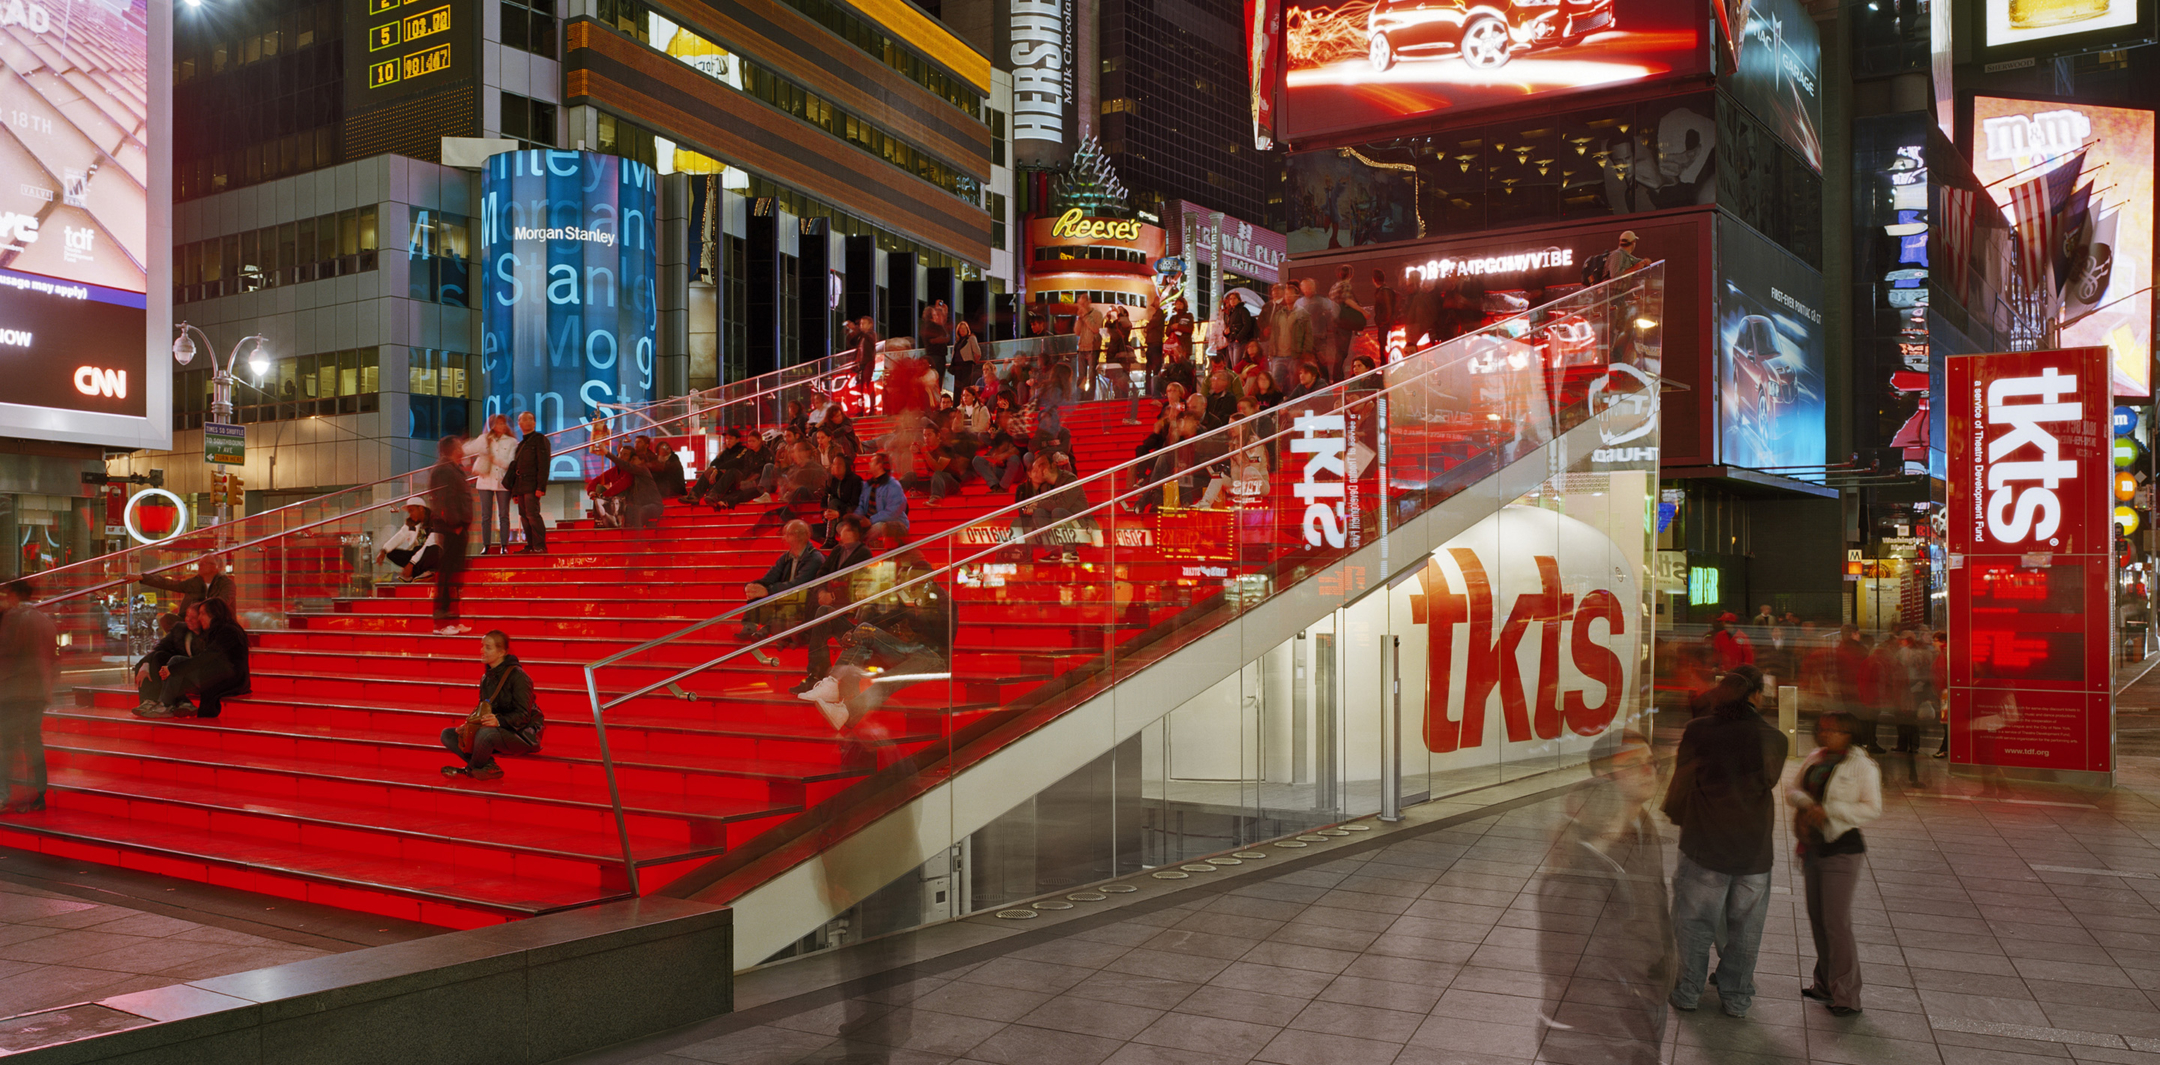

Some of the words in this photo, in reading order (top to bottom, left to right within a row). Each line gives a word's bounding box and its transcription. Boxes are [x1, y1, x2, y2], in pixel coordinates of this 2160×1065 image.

[381, 27, 390, 45] 5
[378, 63, 393, 83] 10
[1782, 53, 1815, 97] GARAGE
[1987, 59, 2034, 71] SHERWOOD
[1063, 67, 1072, 105] Milk
[12, 110, 28, 129] 18
[31, 114, 52, 134] TH
[1052, 208, 1142, 240] Reese's
[64, 225, 95, 251] tdf
[515, 226, 563, 243] Morgan
[565, 226, 616, 247] Stanley
[1231, 258, 1260, 274] HOTEL
[32, 280, 55, 295] may
[55, 285, 88, 300] apply)
[74, 365, 127, 399] CNN
[1974, 388, 1982, 418] service
[1974, 420, 1983, 429] of
[213, 438, 244, 447] SOUTHBOUND
[223, 446, 233, 454] AVE
[1974, 430, 1984, 463] Theatre
[1986, 367, 2083, 544] tkts
[1973, 465, 1984, 519] Development
[1882, 537, 1925, 545] Washington
[1975, 521, 1985, 542] Fund
[1409, 547, 1625, 753] tkts
[2004, 747, 2050, 758] www.tdf.org
